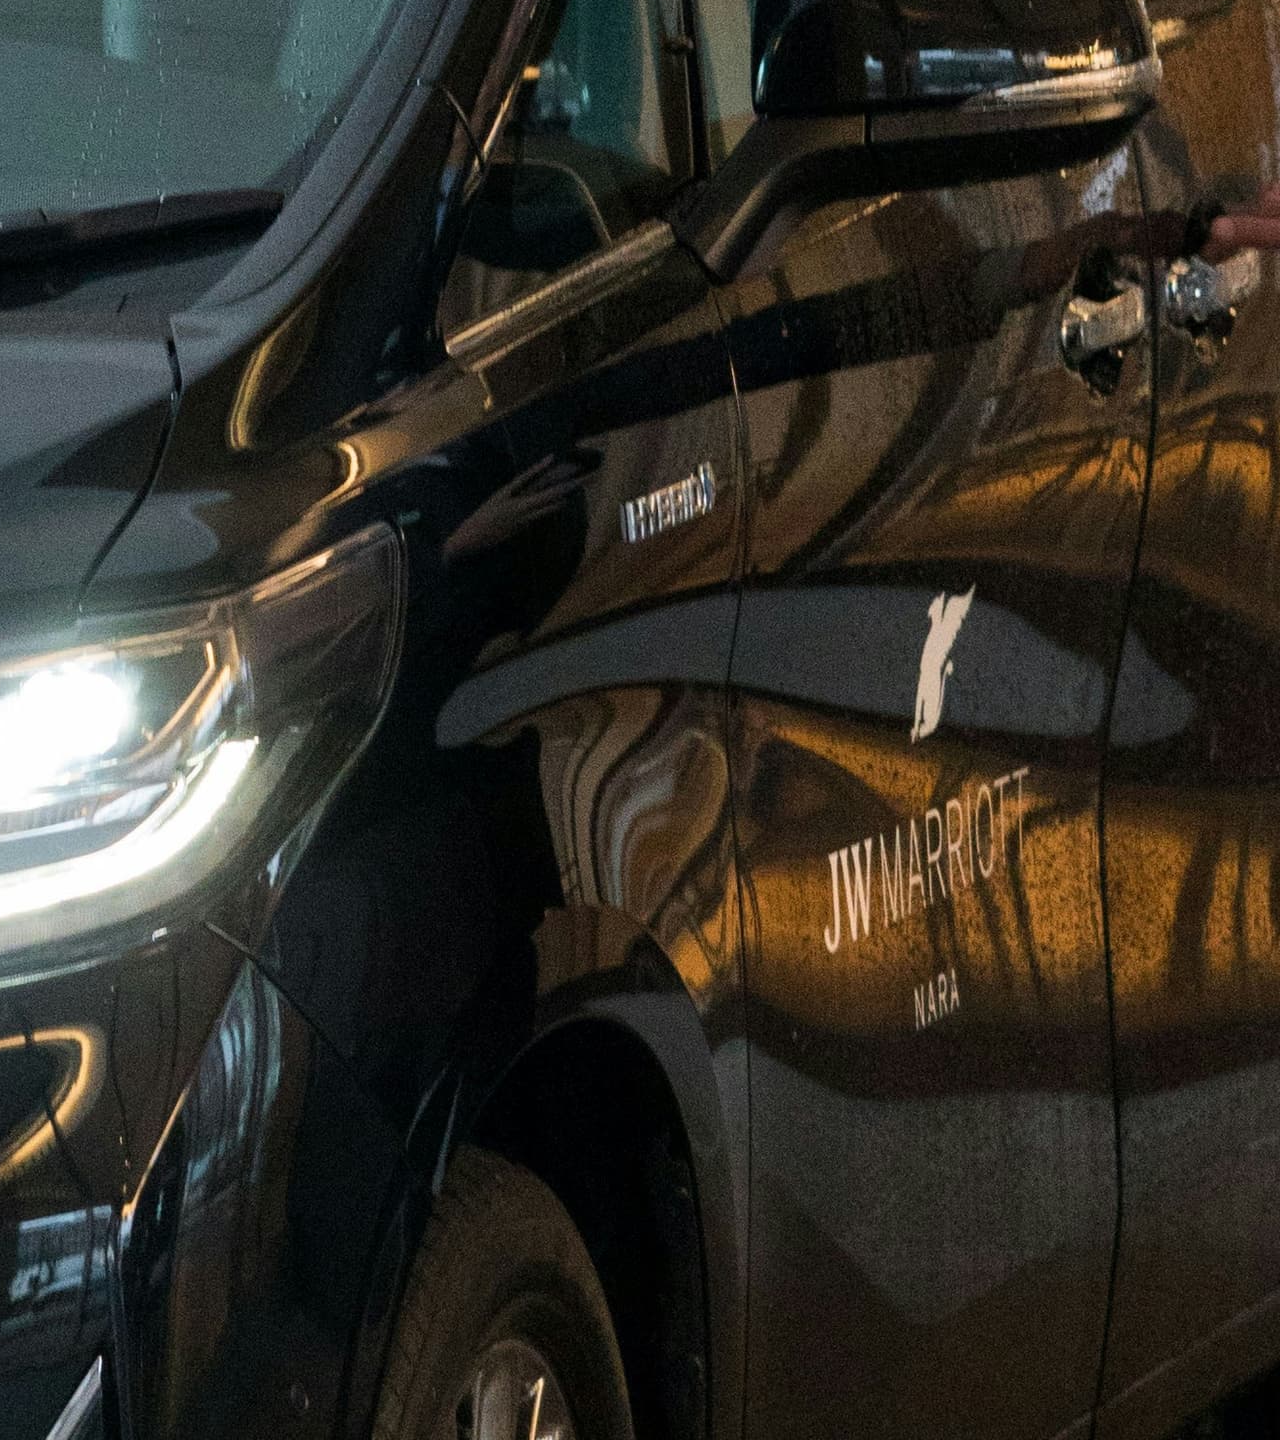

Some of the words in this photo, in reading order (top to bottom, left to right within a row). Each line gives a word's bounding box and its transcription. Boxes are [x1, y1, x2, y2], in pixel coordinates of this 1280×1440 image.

[621, 461, 716, 543] HYBRID
[824, 837, 872, 953] JW
[877, 767, 1029, 928] MARRIOTT
[913, 968, 960, 1031] NARA
